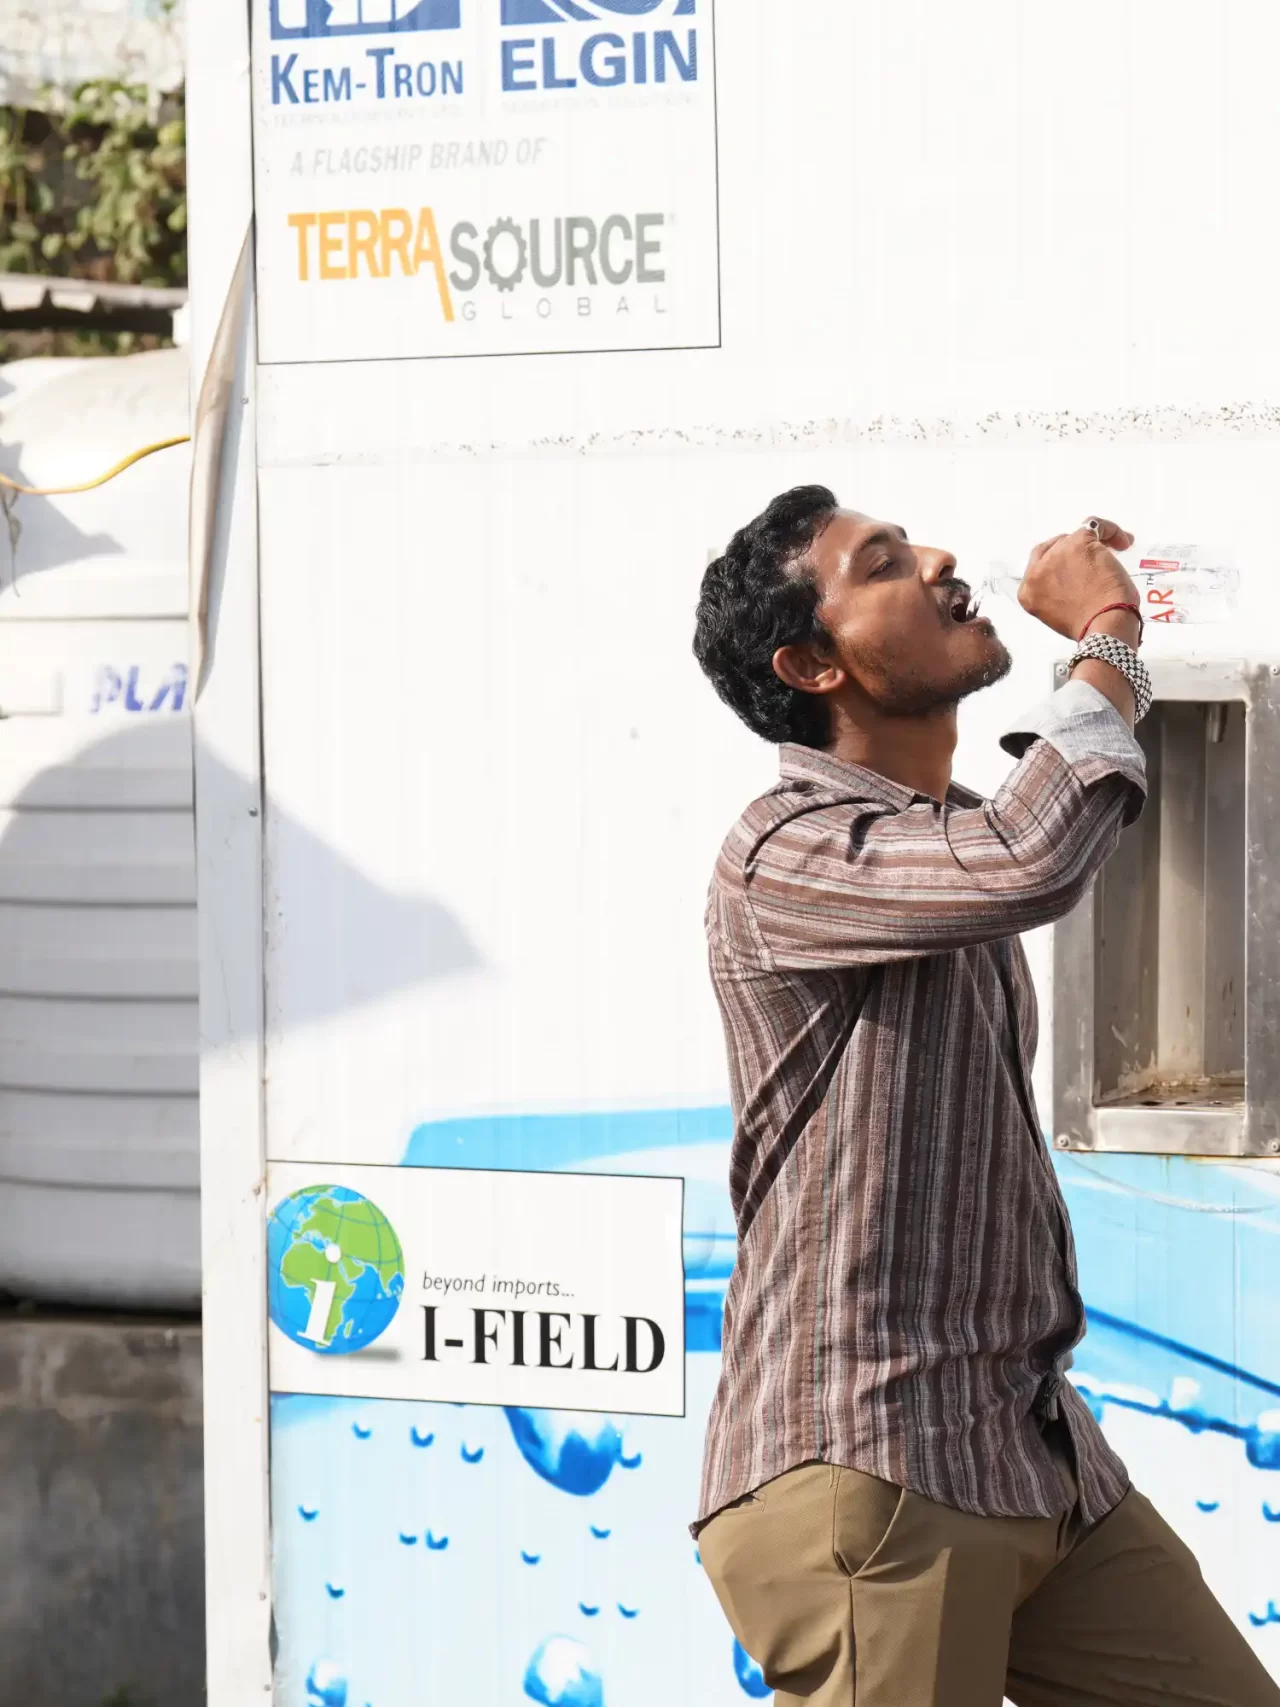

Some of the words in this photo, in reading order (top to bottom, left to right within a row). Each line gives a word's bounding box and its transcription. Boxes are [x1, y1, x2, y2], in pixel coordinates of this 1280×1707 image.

[501, 29, 698, 92] ELGIN
[312, 143, 423, 176] FLAGSHIP
[430, 139, 508, 170] BRAND
[516, 137, 547, 164] OF
[462, 295, 667, 322] GLOBAL
[421, 1271, 486, 1297] beyond
[492, 1275, 576, 1300] imports...
[420, 1305, 666, 1374] I-FIELD
